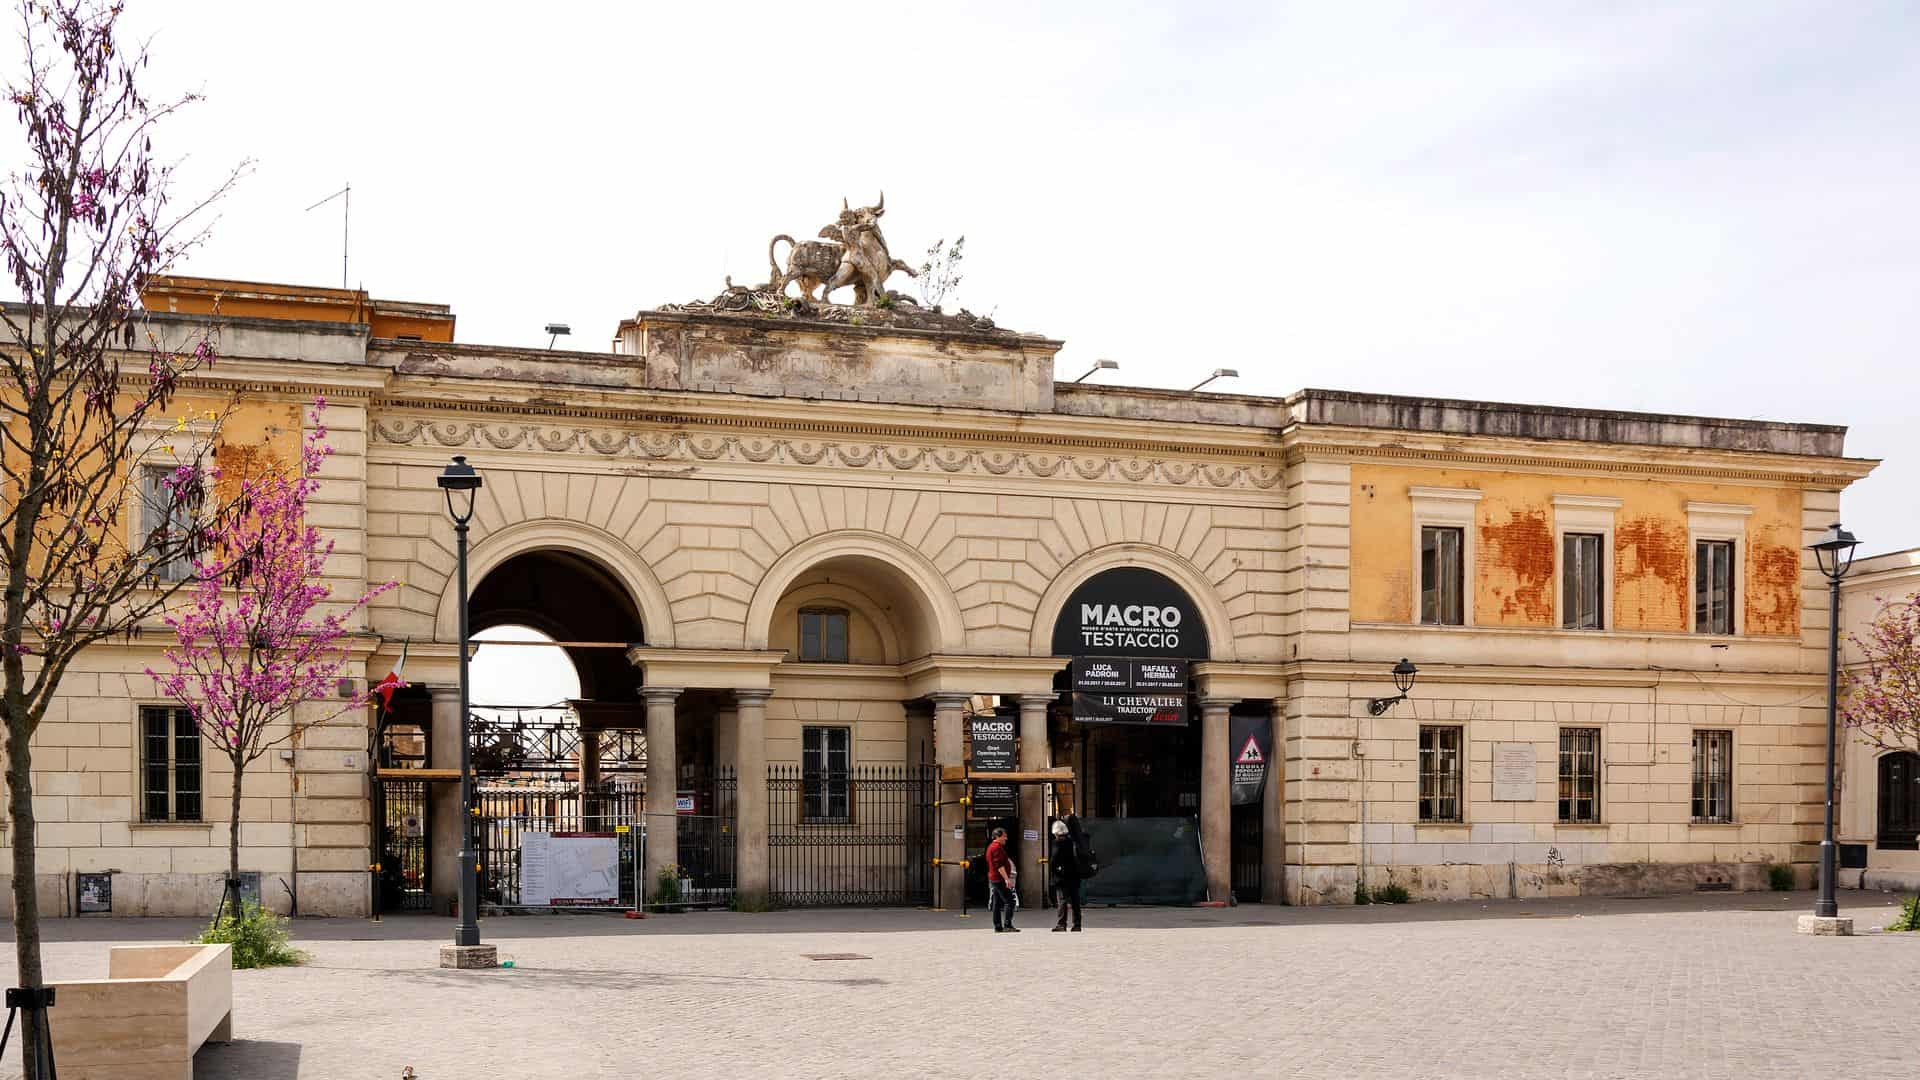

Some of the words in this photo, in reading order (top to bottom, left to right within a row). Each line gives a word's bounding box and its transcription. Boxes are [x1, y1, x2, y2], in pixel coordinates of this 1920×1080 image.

[1081, 604, 1182, 627] MACRO
[1081, 631, 1179, 648] TESTACCIO
[1085, 670, 1119, 678] PADRONI
[1103, 696, 1114, 706] LI
[1118, 696, 1183, 707] CHEVALIER
[1117, 706, 1158, 714] TRAJECTORY
[972, 722, 1013, 731] MACRO
[973, 733, 1013, 741] TESTACCIO
